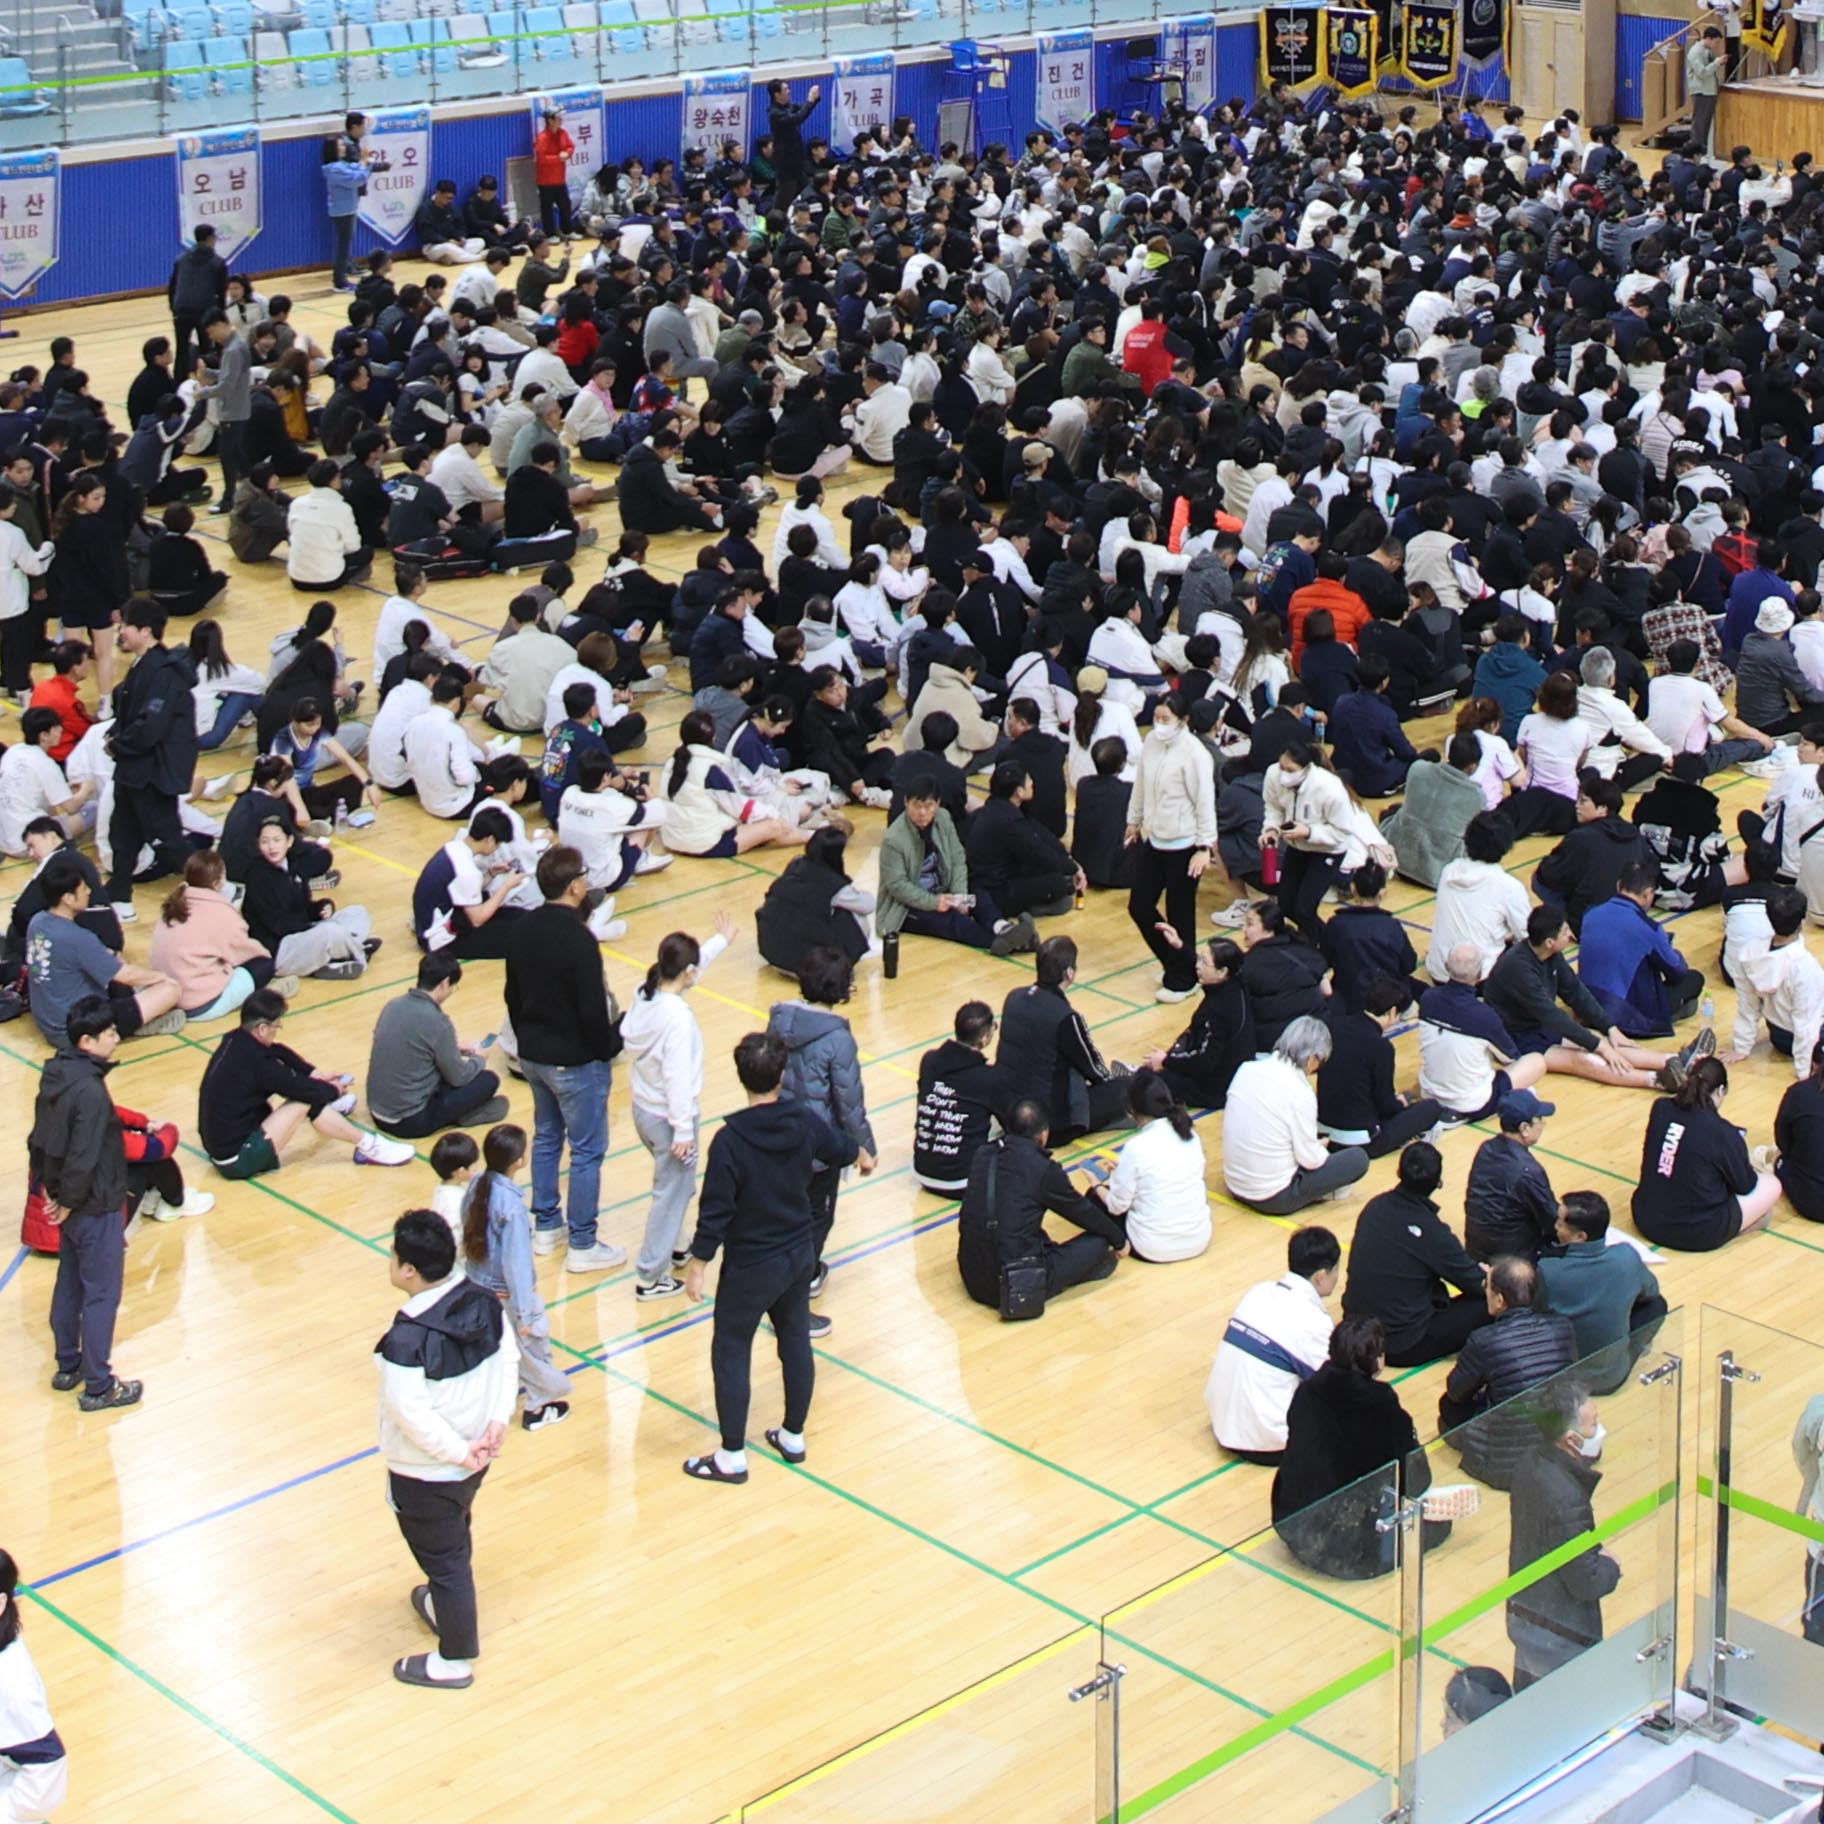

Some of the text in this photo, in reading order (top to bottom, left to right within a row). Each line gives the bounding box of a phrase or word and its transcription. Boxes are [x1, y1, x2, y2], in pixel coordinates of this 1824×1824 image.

[1047, 62, 1084, 84] 진 건
[843, 87, 884, 109] 가 곡
[1051, 85, 1081, 102] CLUB
[692, 105, 741, 130] 왕숙천
[577, 123, 593, 146] 부
[401, 147, 419, 168] 오
[193, 167, 248, 195] 오 남
[373, 175, 416, 192] CLUB
[24, 192, 46, 217] 산
[199, 197, 243, 216] CLUB
[1671, 438, 1705, 454] KOREA
[574, 806, 595, 819] YONEX
[1656, 1122, 1686, 1179] RYDER
